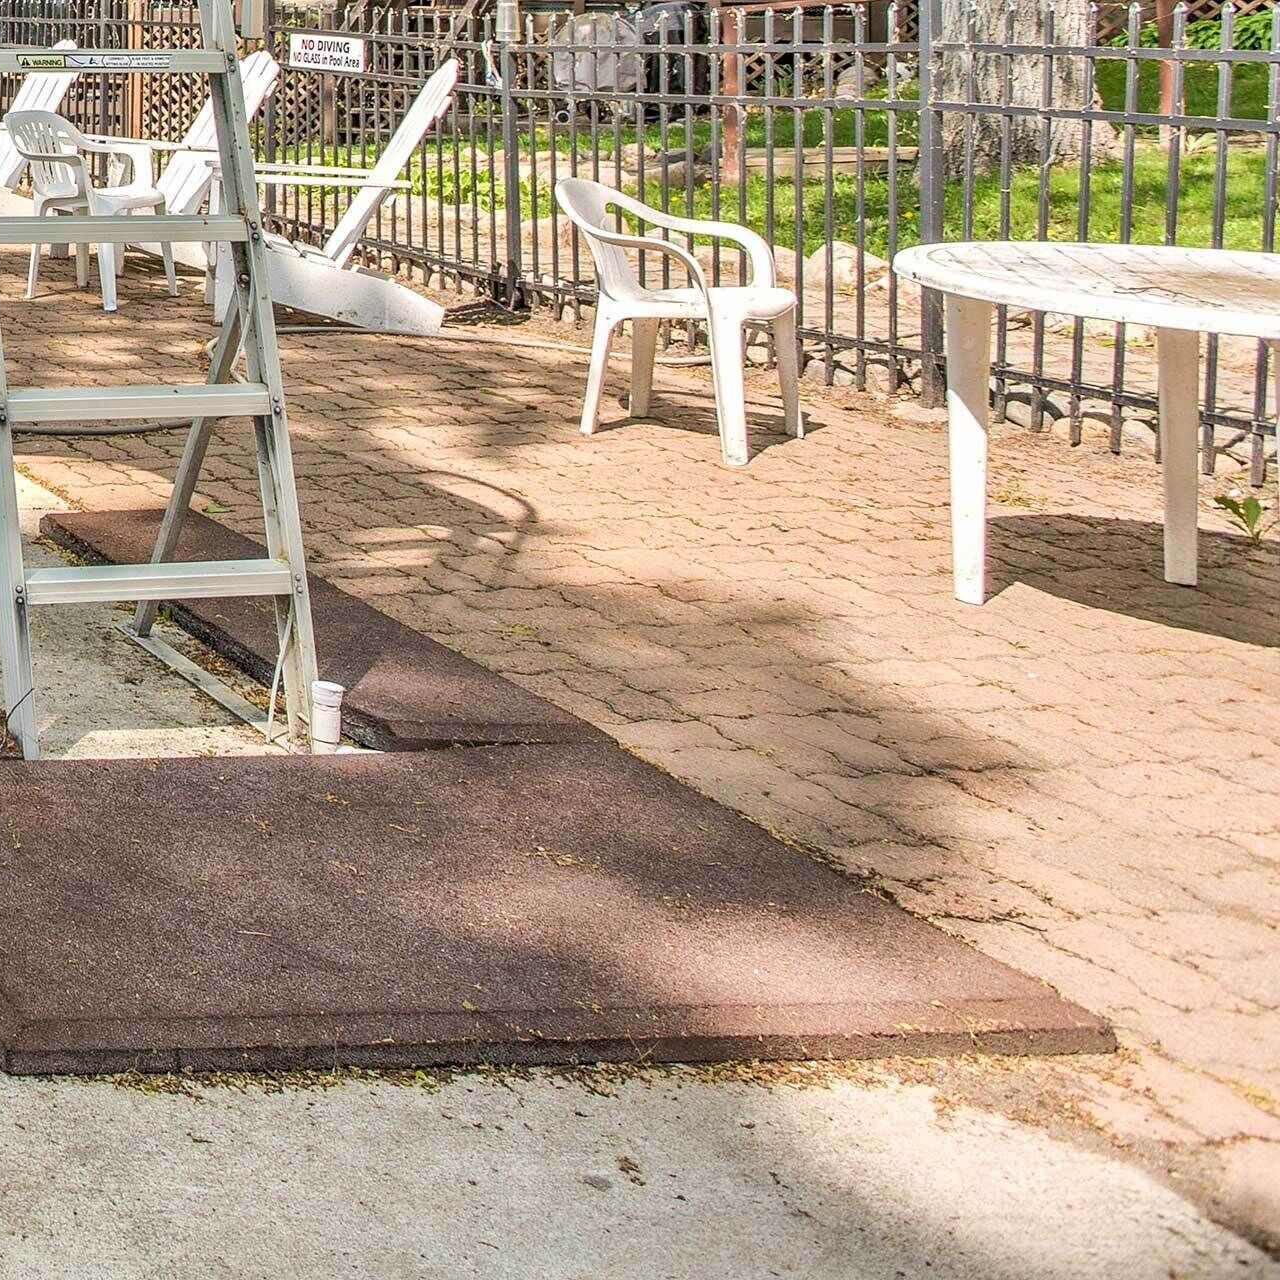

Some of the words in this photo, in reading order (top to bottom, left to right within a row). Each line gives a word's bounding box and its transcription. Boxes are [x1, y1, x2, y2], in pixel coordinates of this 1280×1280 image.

[301, 39, 315, 50] NO
[317, 40, 350, 53] DIVING
[293, 51, 302, 62] NO
[303, 52, 321, 64] GLASS
[322, 53, 328, 64] in
[329, 55, 343, 67] Pool
[344, 56, 360, 68] Area
